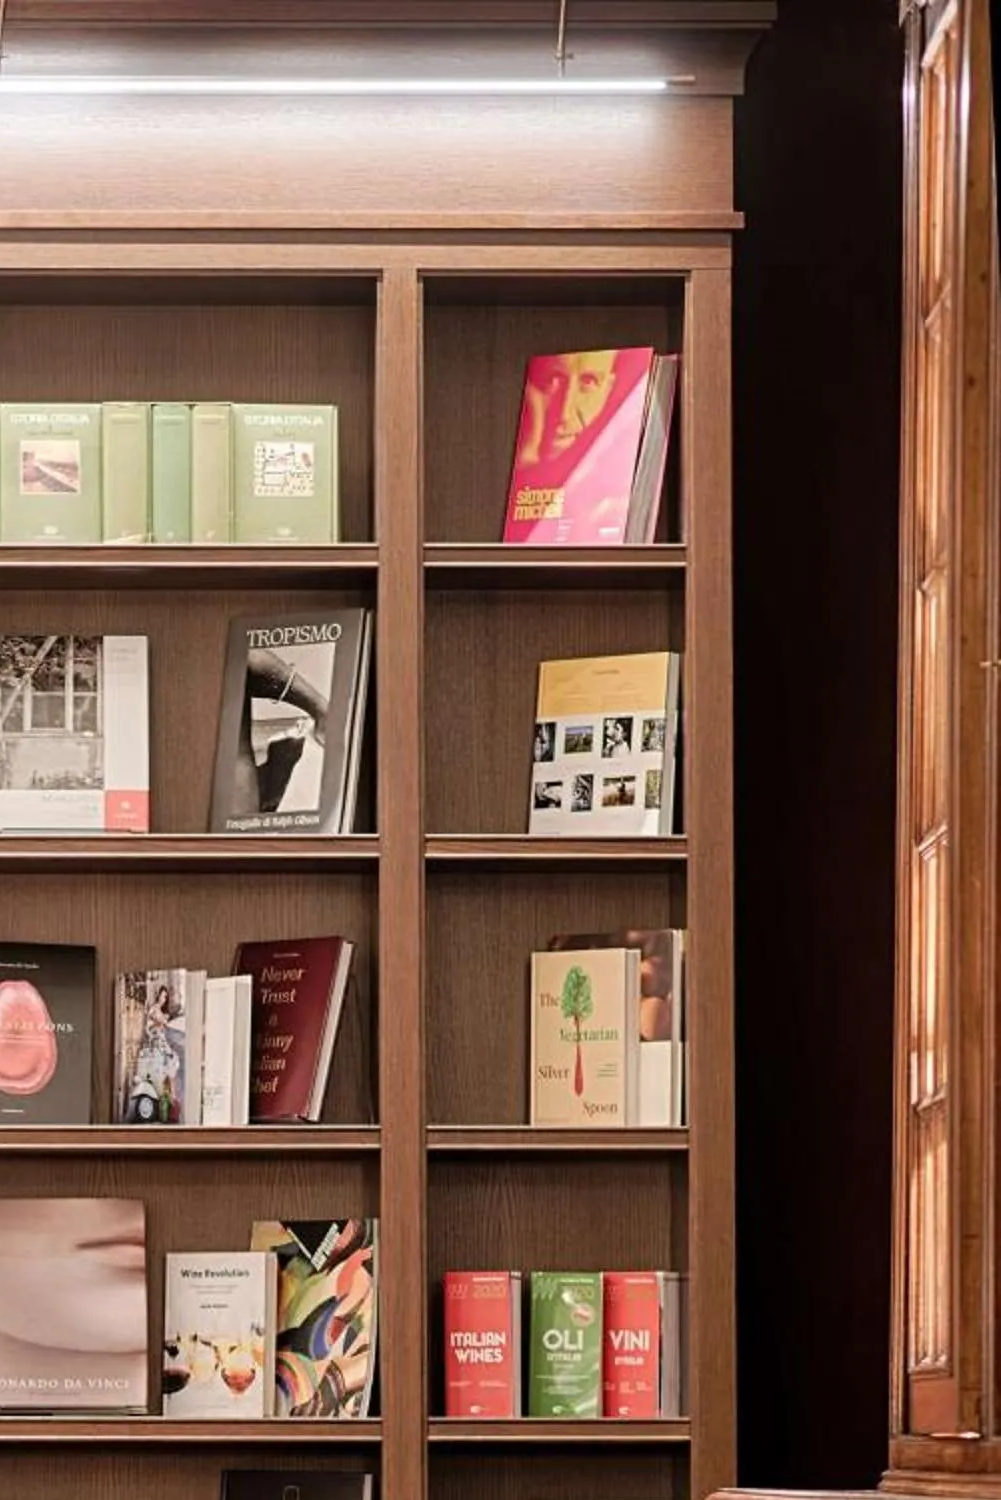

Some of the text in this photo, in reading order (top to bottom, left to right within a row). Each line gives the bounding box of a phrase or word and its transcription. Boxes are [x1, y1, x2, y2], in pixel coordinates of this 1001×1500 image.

[246, 623, 342, 648] TROPISMO
[260, 966, 306, 983] Never
[260, 988, 297, 1004] Trust
[539, 994, 559, 1008] The
[559, 1028, 619, 1043] Vegetarian
[538, 1065, 570, 1080] Silver
[583, 1101, 618, 1118] Spoon
[450, 1330, 506, 1347] ITALIAN
[542, 1329, 584, 1351] OLI
[609, 1329, 650, 1351] VINI
[455, 1347, 504, 1364] WINES
[64, 1377, 82, 1390] DA
[88, 1378, 130, 1390] VINCI
